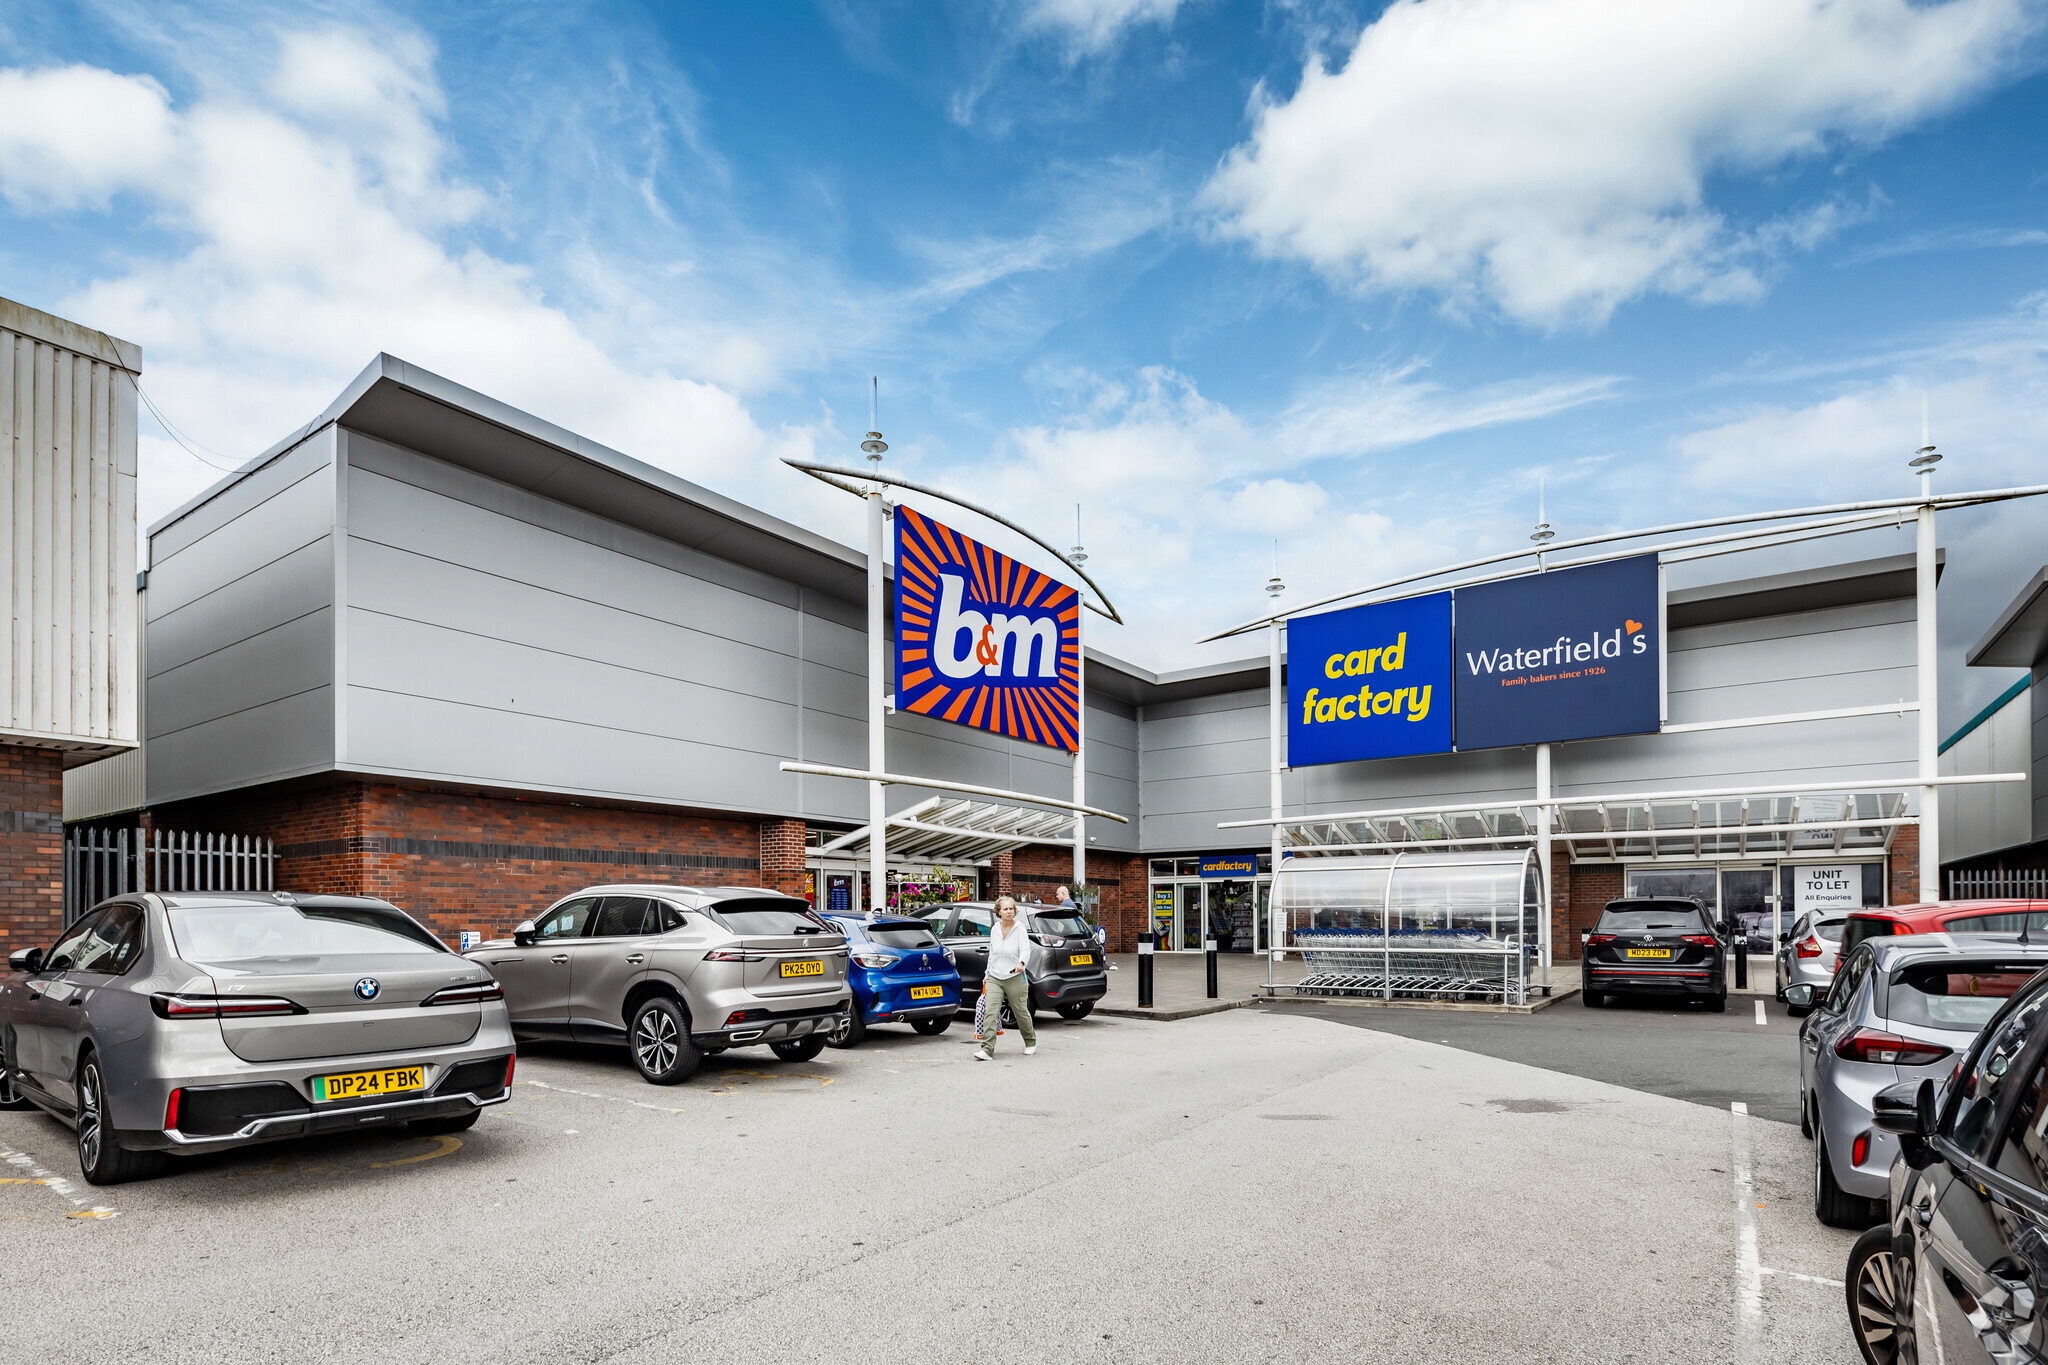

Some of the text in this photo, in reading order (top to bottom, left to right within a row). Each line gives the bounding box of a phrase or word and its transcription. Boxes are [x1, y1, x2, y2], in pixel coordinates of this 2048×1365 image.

[934, 573, 1059, 678] b&m
[1324, 632, 1407, 679] card
[1501, 666, 1606, 687] Family bakers since 1926
[1303, 685, 1432, 725] factory
[1202, 860, 1252, 872] cardfactory
[1812, 870, 1843, 879] UNIT
[1806, 880, 1850, 890] TO LET
[784, 964, 805, 975] PK25
[329, 1070, 420, 1095] DP24 FBK
